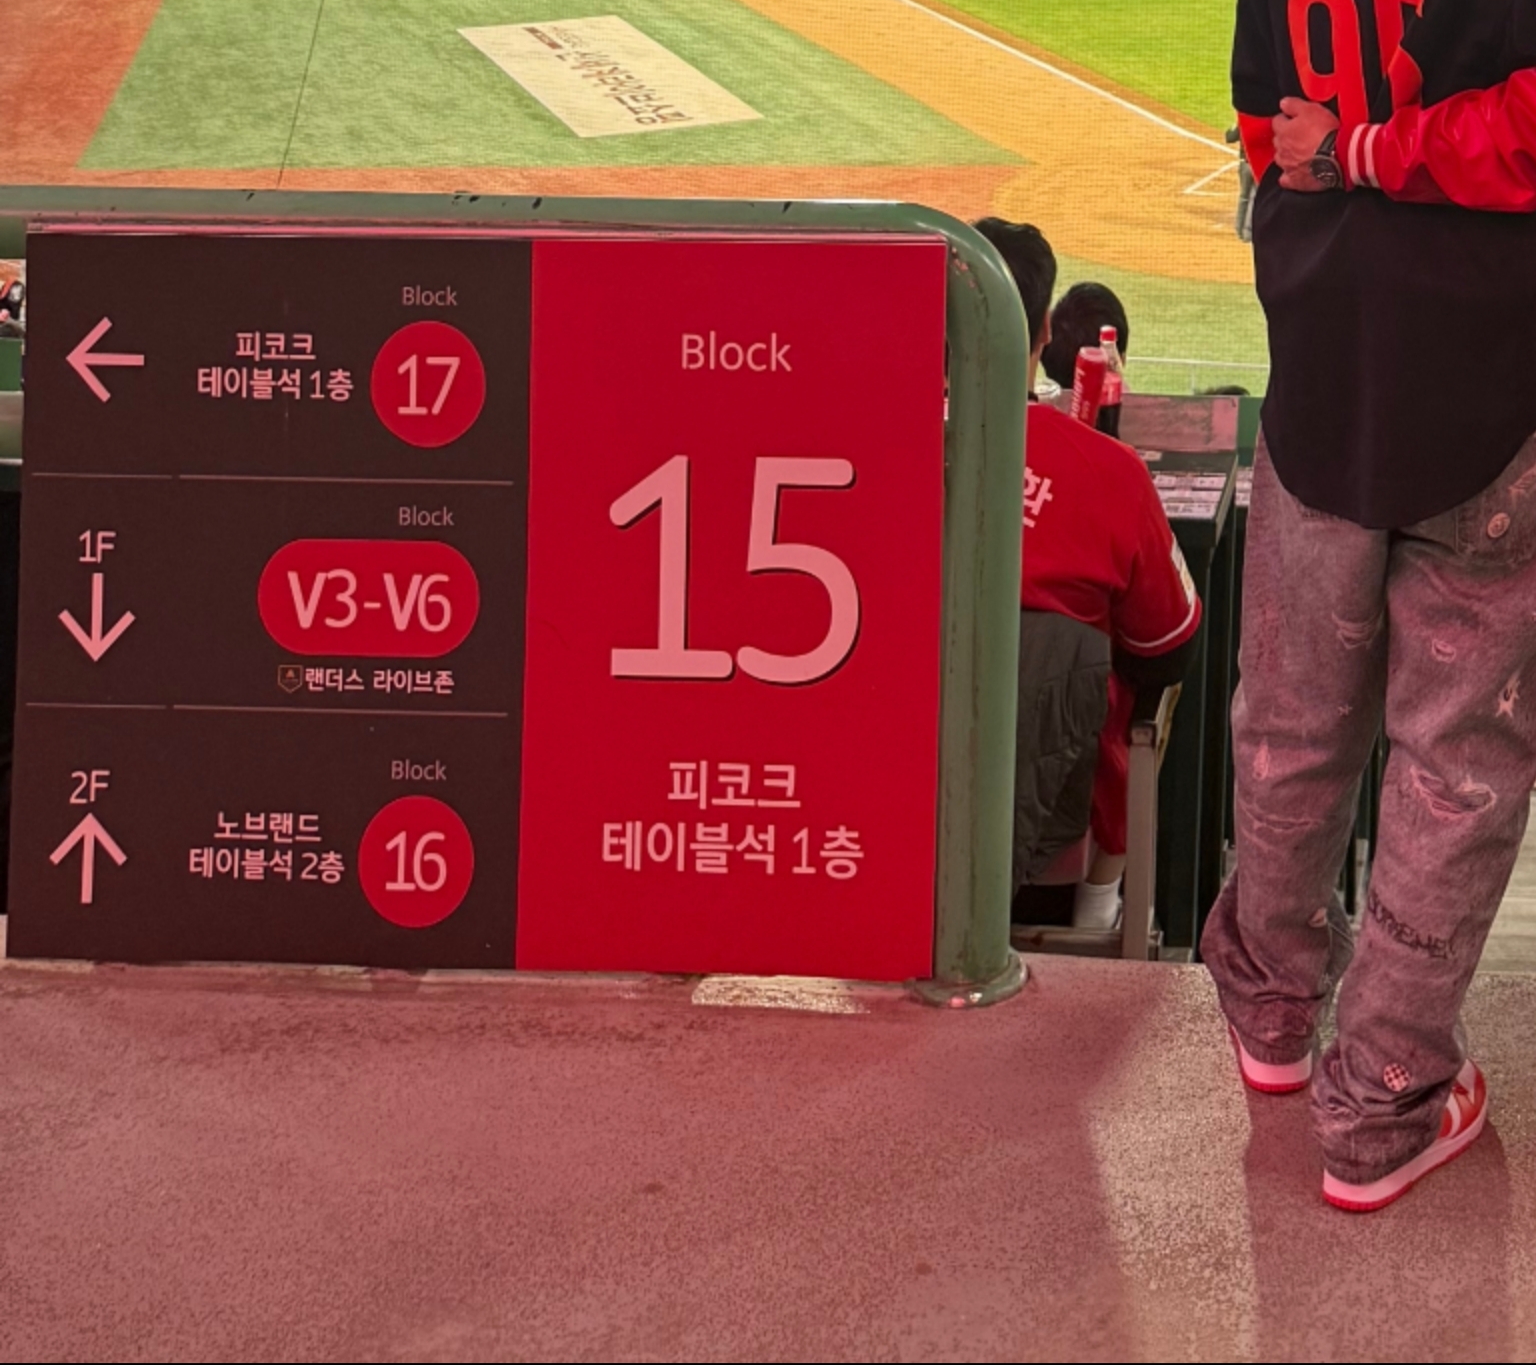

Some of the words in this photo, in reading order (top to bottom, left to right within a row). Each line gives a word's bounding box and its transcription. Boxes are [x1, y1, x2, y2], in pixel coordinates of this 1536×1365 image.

[402, 285, 458, 307] Block
[235, 331, 317, 361] 피코크
[680, 331, 792, 372] Block
[198, 367, 302, 400] 테이블석
[309, 369, 354, 401] 1층
[396, 354, 461, 416] 17
[398, 505, 455, 527] Block
[78, 529, 116, 564] 1F
[608, 454, 862, 686] 15
[287, 568, 453, 633] V3-V6
[304, 667, 365, 693] 랜더스
[372, 668, 455, 695] 라이브존
[68, 769, 111, 805] 2F
[390, 759, 447, 781] Block
[667, 759, 802, 810] 피코크
[213, 811, 323, 844] 노브랜드
[189, 847, 293, 882] 테이블석
[300, 851, 346, 885] 2층
[384, 831, 448, 893] 16
[601, 820, 776, 875] 테이블석
[791, 826, 866, 880] 1층
